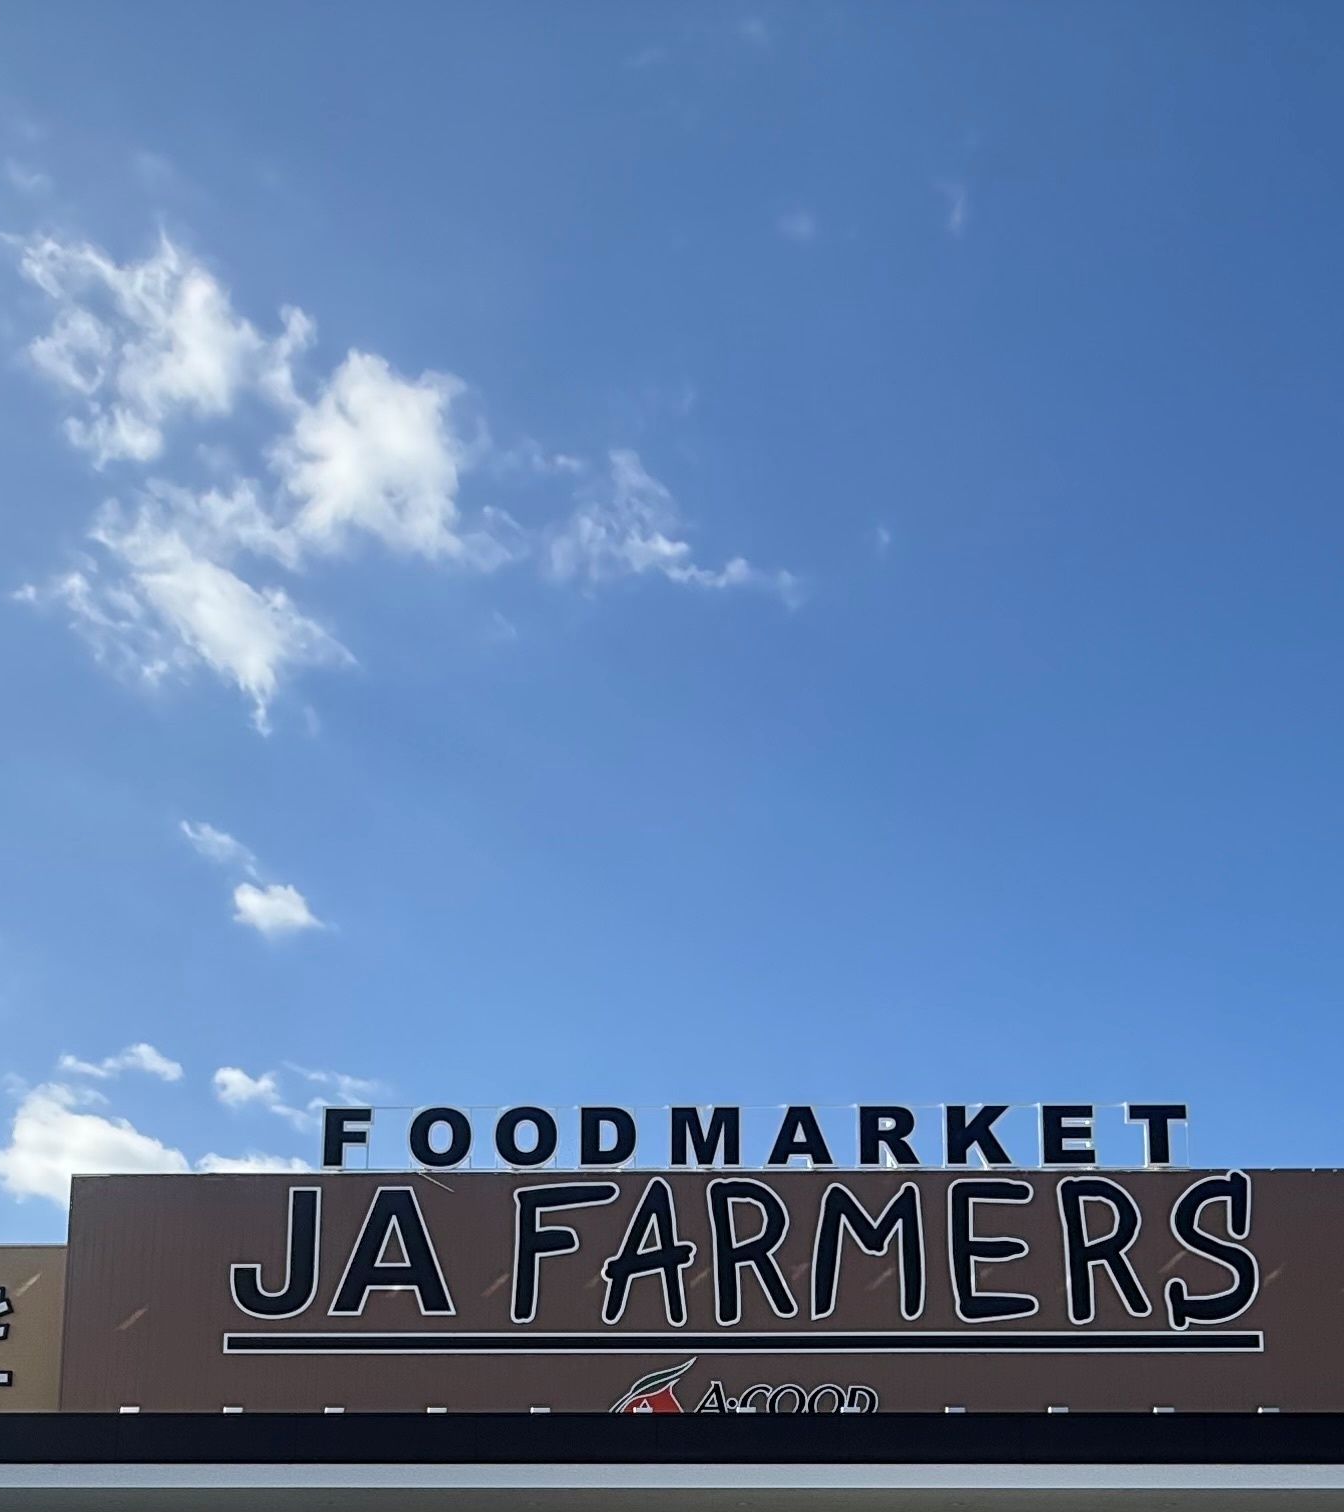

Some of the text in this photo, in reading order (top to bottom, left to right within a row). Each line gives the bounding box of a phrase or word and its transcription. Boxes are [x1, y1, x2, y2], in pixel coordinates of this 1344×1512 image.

[323, 1104, 1188, 1170] FOODMARKET
[230, 1170, 1258, 1330] JA FARMERS
